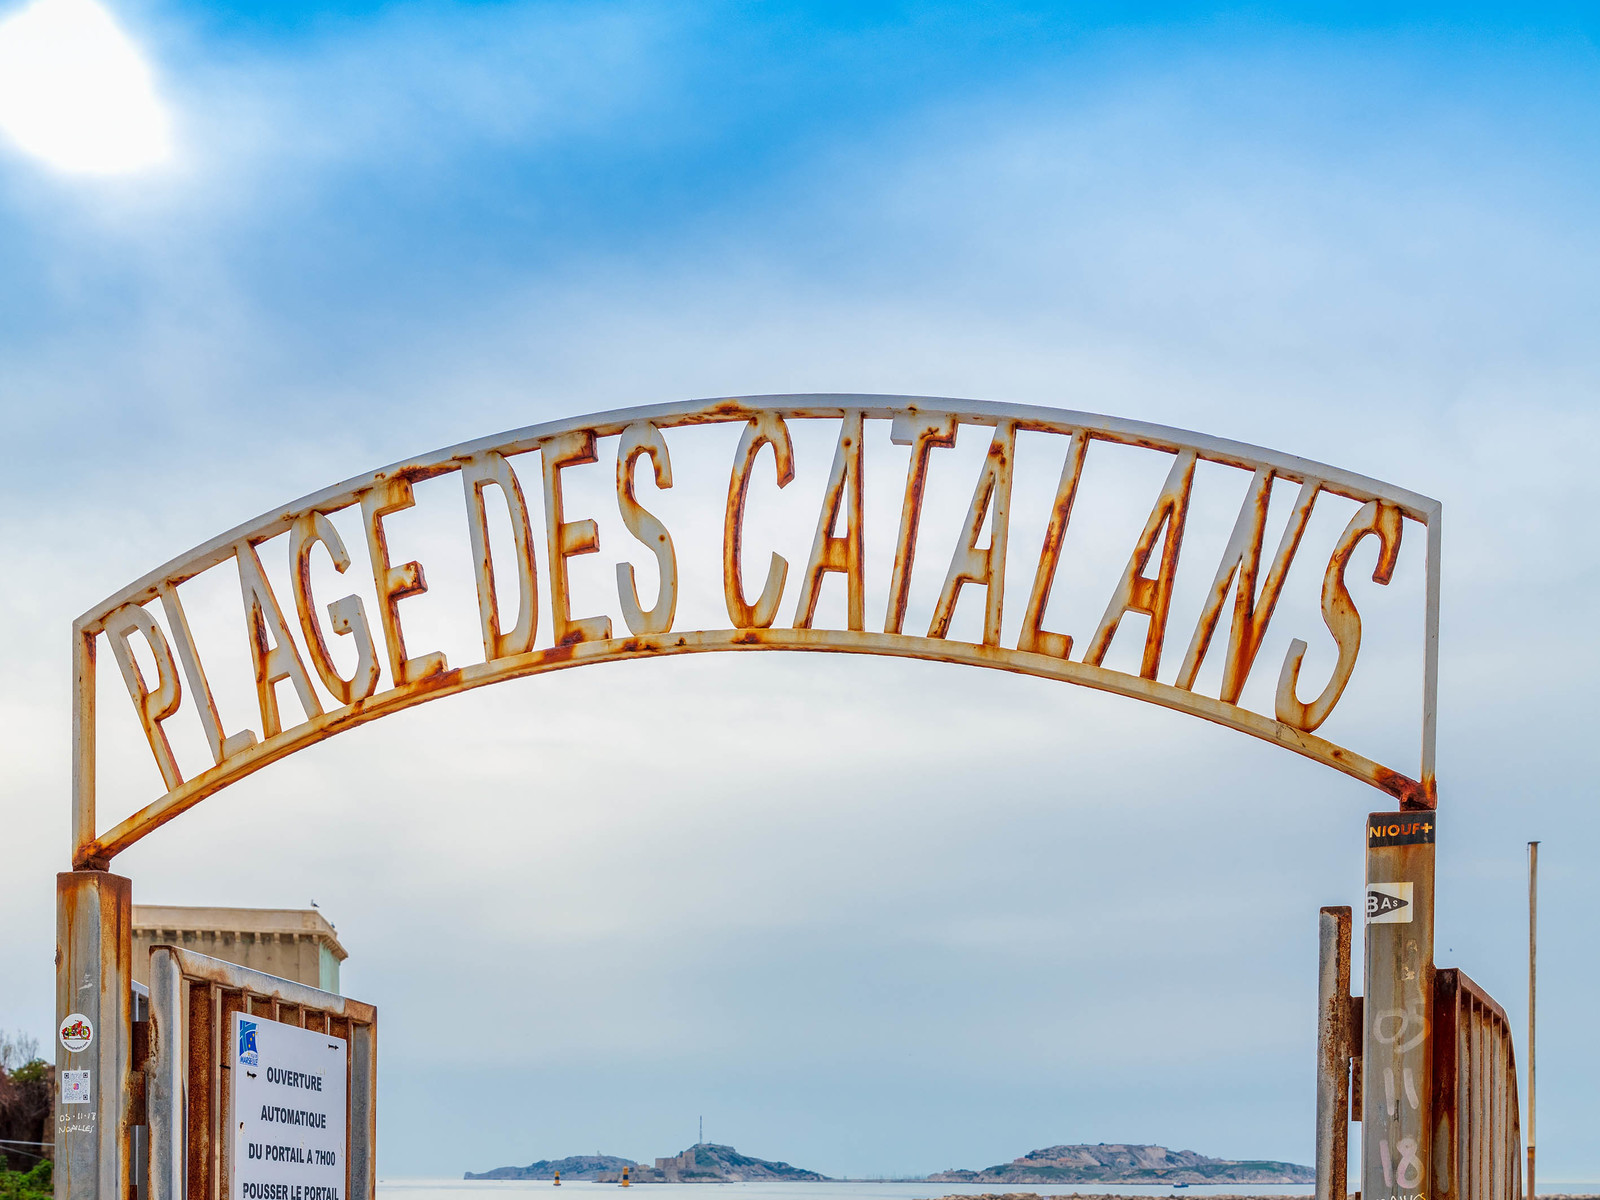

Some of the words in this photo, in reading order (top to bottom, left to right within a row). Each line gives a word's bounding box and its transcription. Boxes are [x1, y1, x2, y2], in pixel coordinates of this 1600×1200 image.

[104, 476, 448, 793] PLAGE
[461, 421, 678, 662] DES
[723, 409, 1404, 734] CATALANS
[266, 1066, 323, 1092] OUVERTURE
[260, 1104, 327, 1130] AUTOMATIQUE
[248, 1143, 263, 1160] DU
[265, 1144, 305, 1165] PORTAIL
[306, 1148, 314, 1165] A
[315, 1149, 336, 1167] 7H00
[242, 1182, 289, 1200] POUSSER
[290, 1184, 302, 1200] LE
